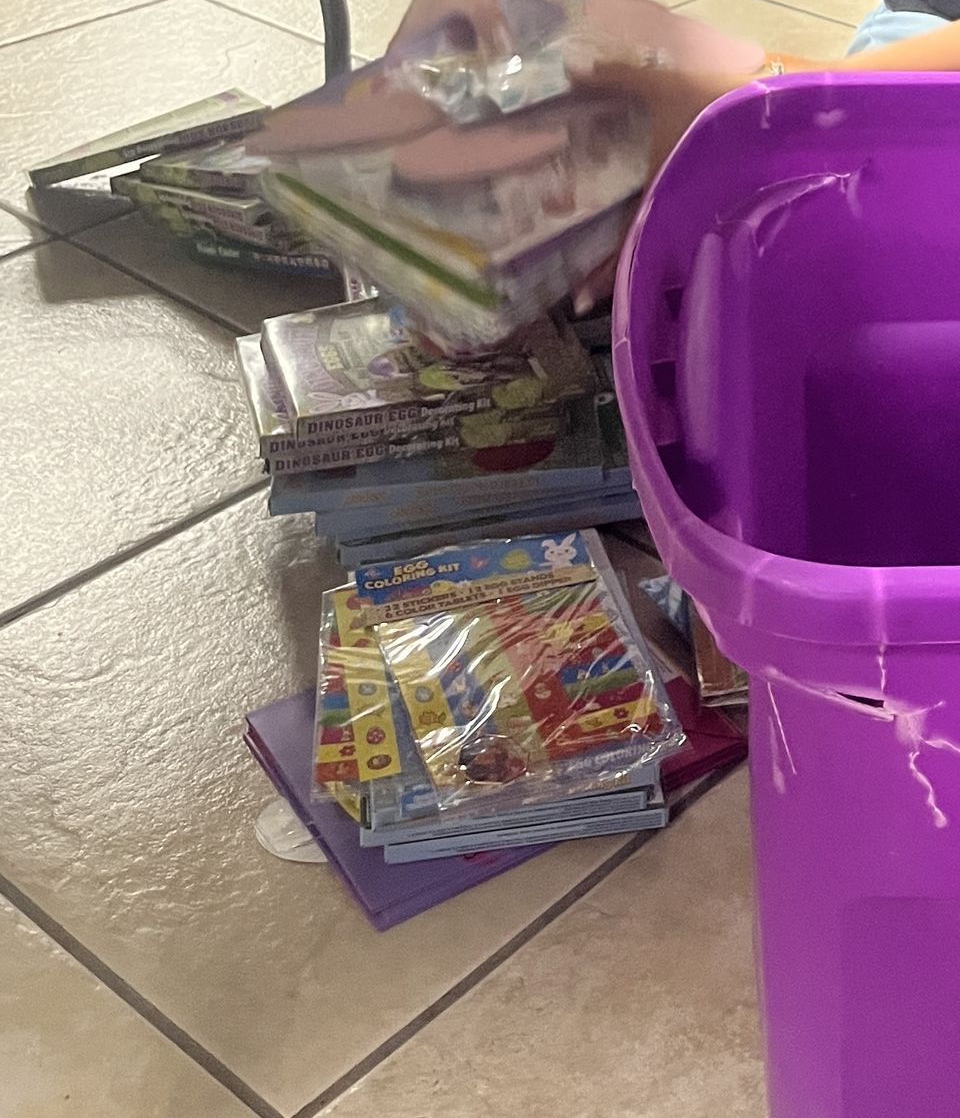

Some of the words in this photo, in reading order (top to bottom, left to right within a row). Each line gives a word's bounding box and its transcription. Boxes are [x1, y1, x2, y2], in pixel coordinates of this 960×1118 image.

[308, 411, 384, 433] DINOSAUR
[388, 406, 417, 422] EGG
[476, 397, 491, 409] Kit
[275, 450, 350, 471] DINOSAUR
[356, 445, 384, 458] EGG
[445, 436, 460, 448] Kit
[364, 567, 437, 590] COLORING
[437, 563, 460, 574] KIT
[393, 560, 429, 576] EGG
[395, 604, 438, 617] COLOR
[439, 592, 487, 609] TABLETS
